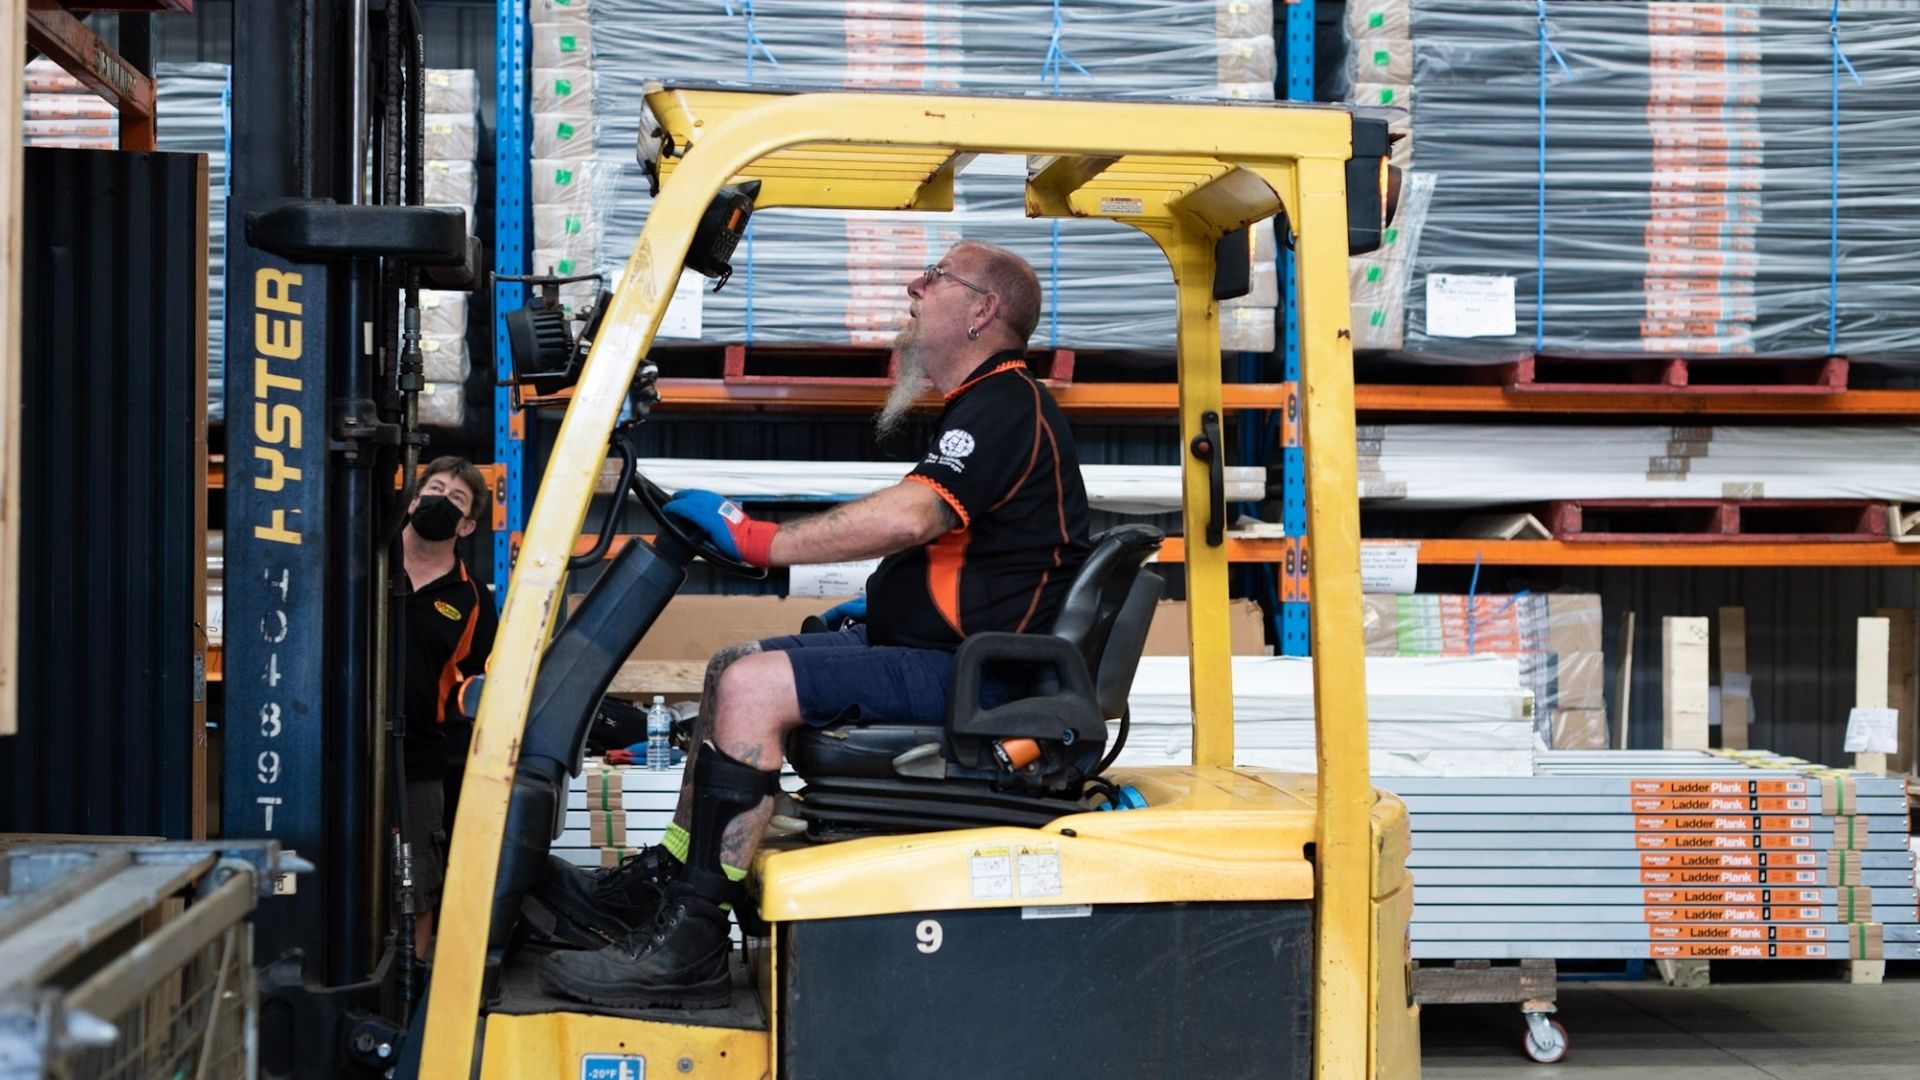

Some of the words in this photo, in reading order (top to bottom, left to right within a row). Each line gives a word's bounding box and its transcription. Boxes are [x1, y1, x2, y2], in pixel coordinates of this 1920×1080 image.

[254, 267, 303, 545] HYSTER
[1671, 783, 1709, 792] Ladder
[1711, 783, 1742, 792] Plank
[1672, 800, 1710, 810] Ladder
[1712, 800, 1742, 810] Plank
[1676, 819, 1713, 828] Ladder
[1716, 819, 1746, 828] Plank
[1676, 838, 1713, 847] Ladder
[1716, 838, 1746, 847] Plank
[1681, 856, 1719, 866] Ladder
[1722, 856, 1752, 866] Plank
[1681, 872, 1719, 882] Ladder
[1722, 872, 1752, 882] Plank
[1684, 892, 1722, 902] Ladder
[1725, 892, 1756, 902] Plank
[1684, 910, 1722, 920] Ladder
[1725, 910, 1756, 920] Plank
[915, 919, 943, 954] 9
[1690, 928, 1729, 938] Ladder
[1731, 928, 1762, 938] Plank
[1690, 946, 1729, 956] Ladder
[1731, 946, 1762, 956] Plank
